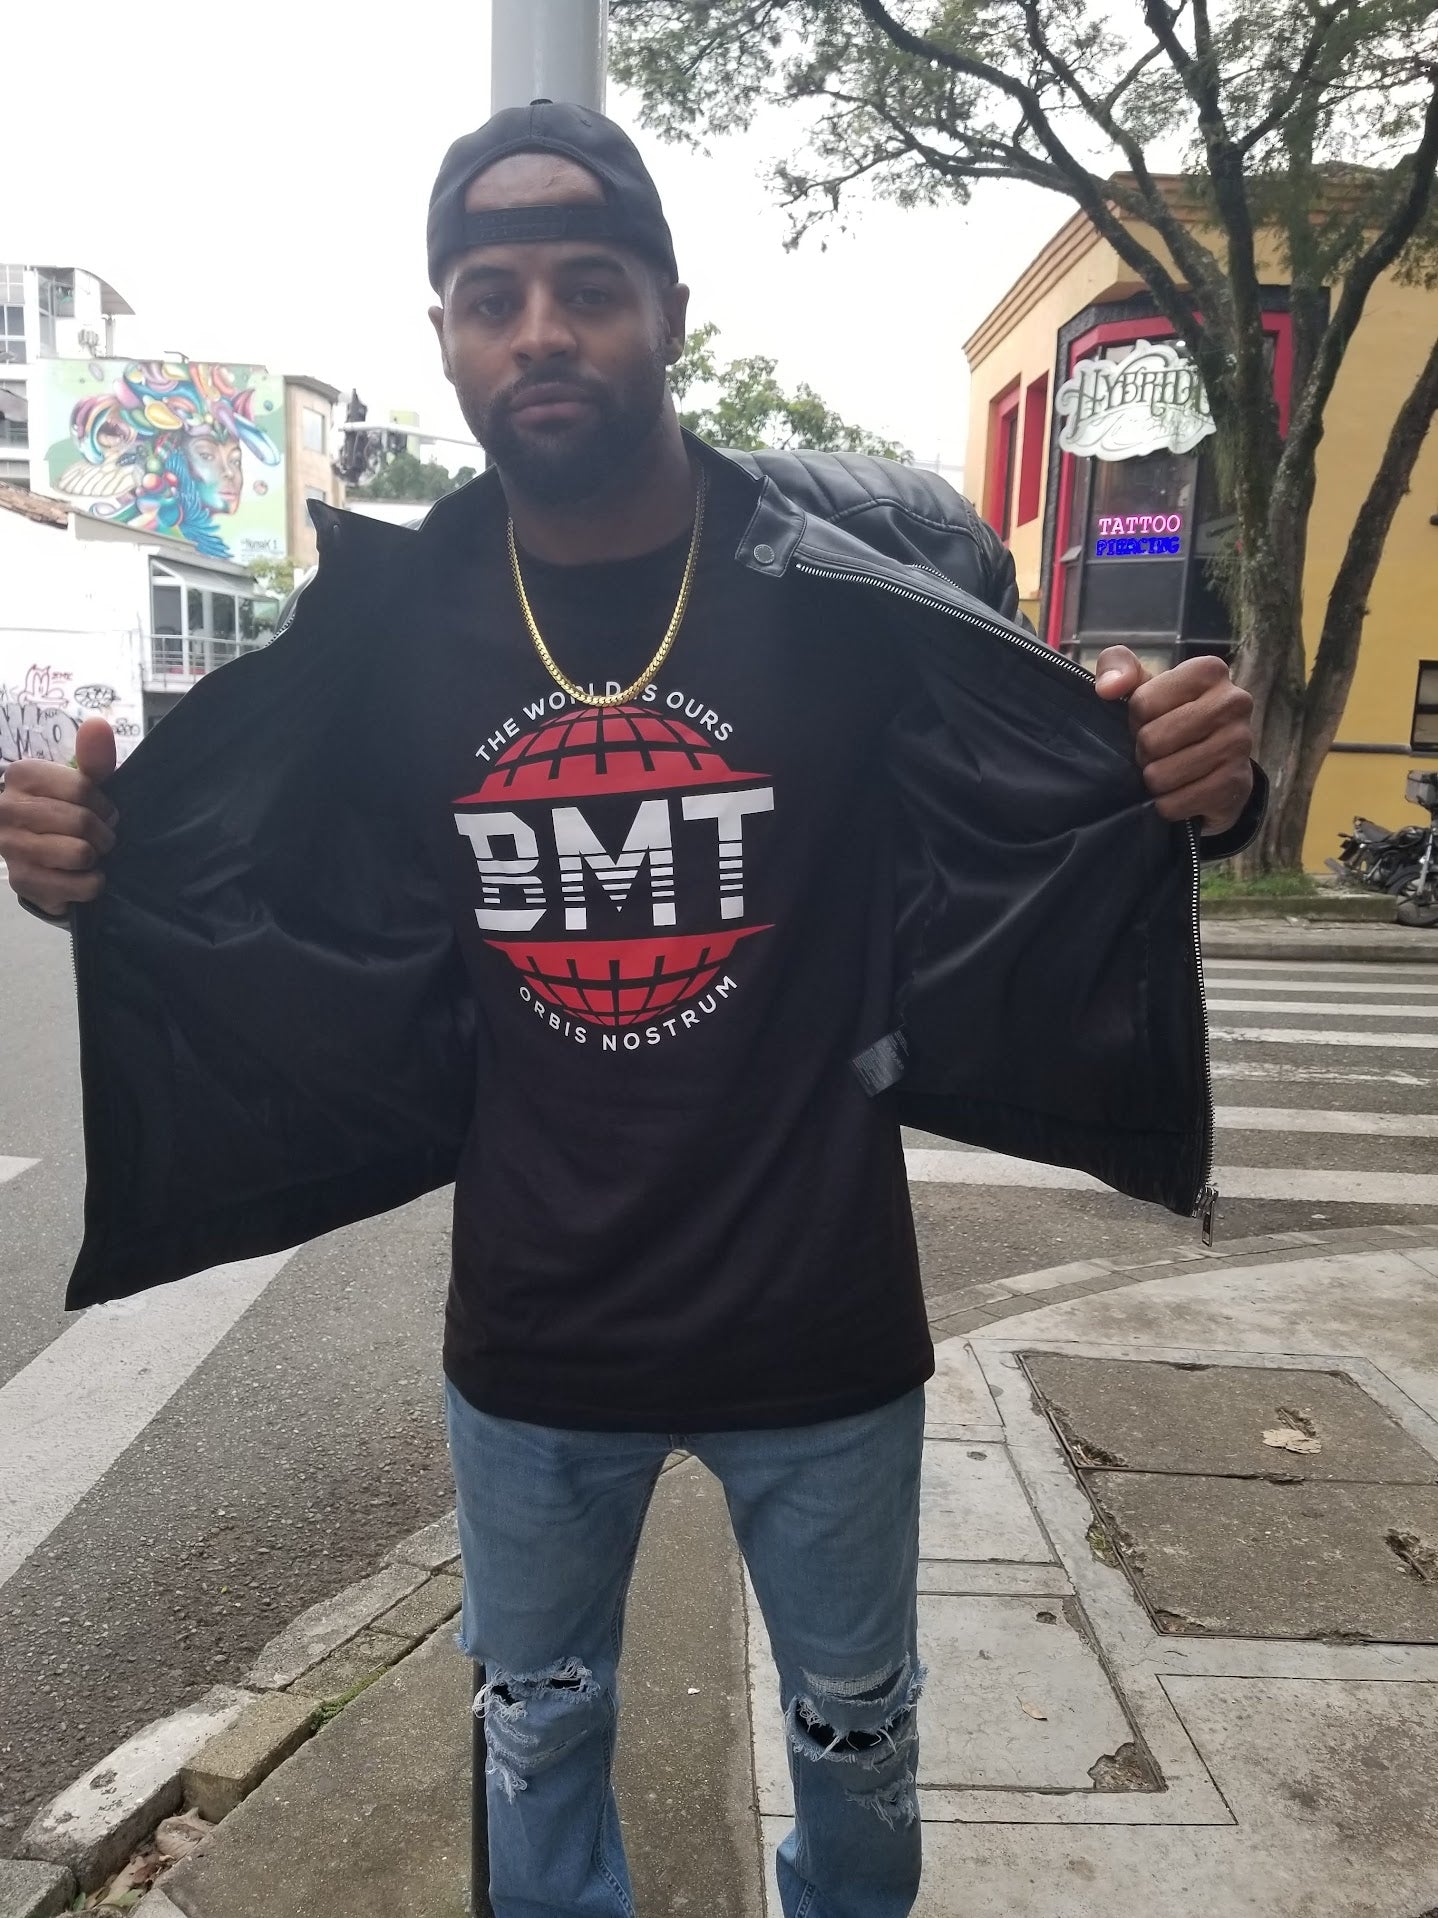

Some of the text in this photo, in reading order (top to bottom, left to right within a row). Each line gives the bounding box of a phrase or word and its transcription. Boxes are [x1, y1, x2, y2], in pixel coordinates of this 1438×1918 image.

[1098, 514, 1181, 535] TATTOO
[475, 717, 521, 762] THE
[666, 691, 733, 742] OURS
[453, 787, 775, 932] BMT
[519, 975, 738, 1051] ORBIS NOSTRUM
